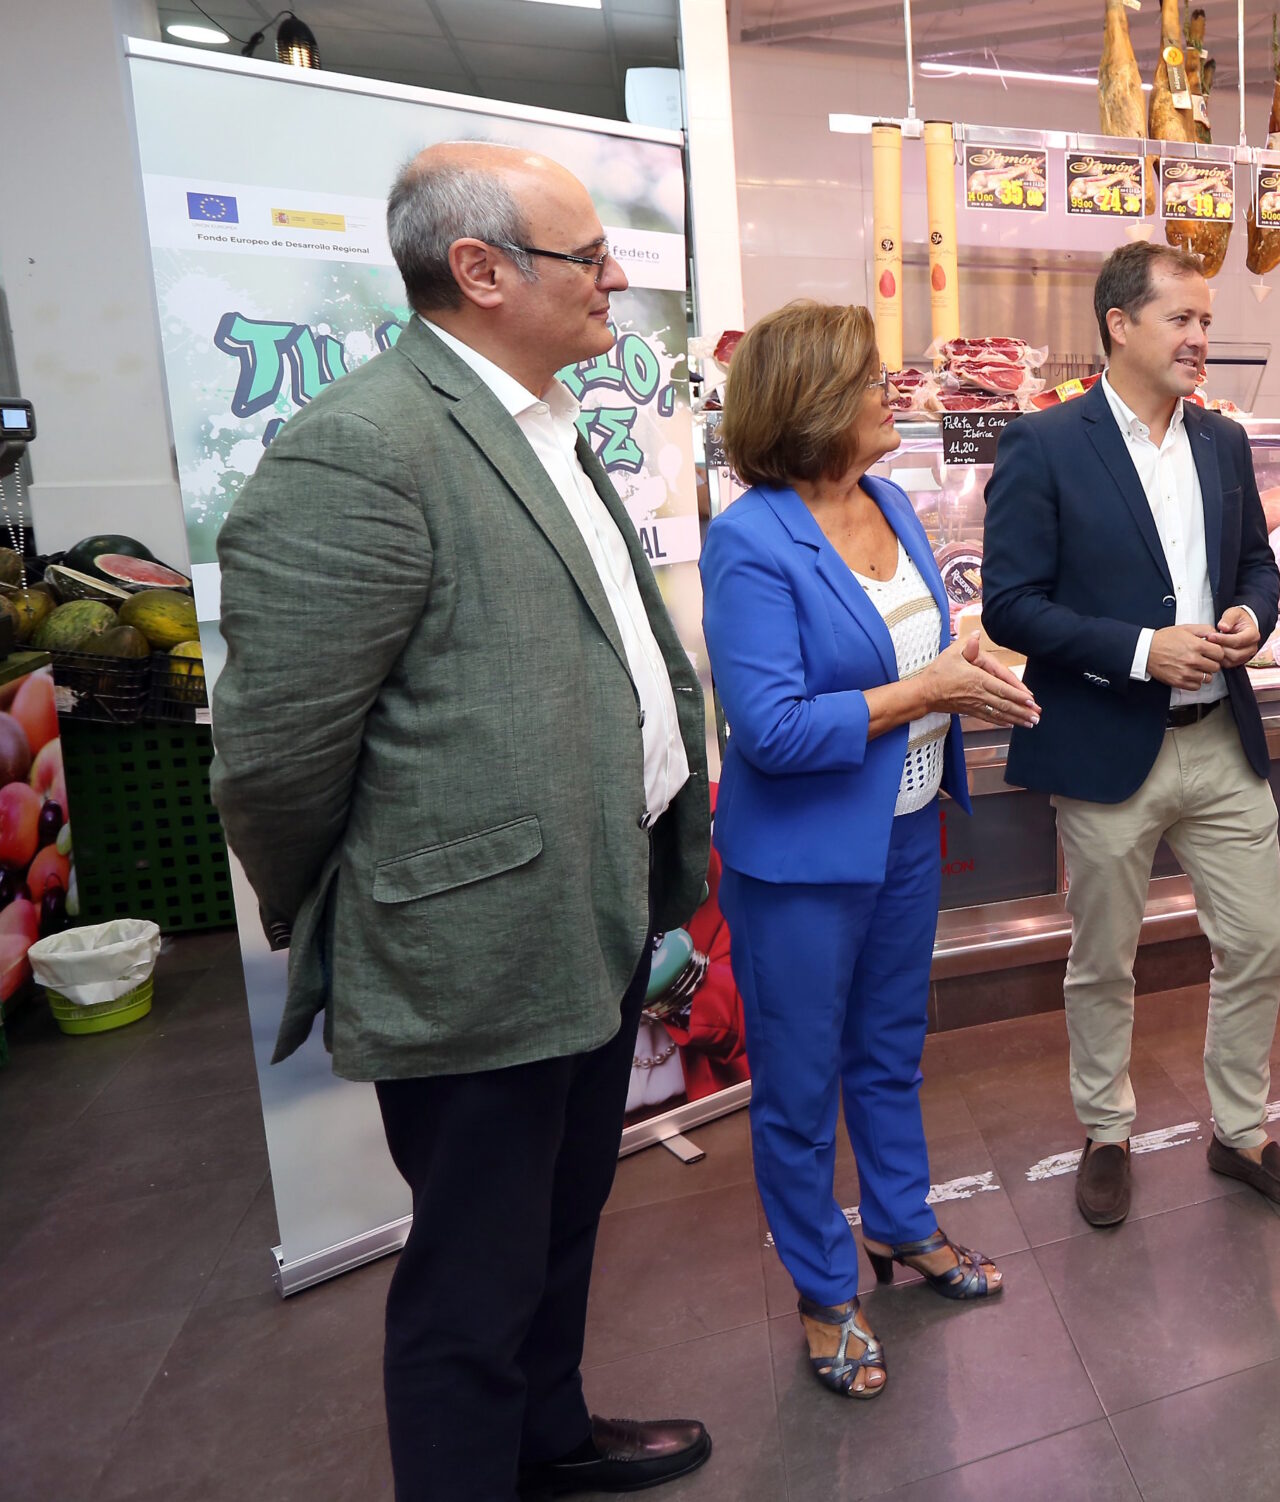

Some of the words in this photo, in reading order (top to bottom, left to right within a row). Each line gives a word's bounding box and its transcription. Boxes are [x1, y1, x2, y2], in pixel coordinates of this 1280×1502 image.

[969, 149, 1036, 166] Jamón
[1070, 156, 1133, 173] Jamón
[1165, 162, 1226, 178] Jamón
[197, 233, 228, 243] Fondo
[230, 236, 270, 247] Europeo
[272, 239, 283, 247] de
[285, 240, 331, 251] Desarrollo
[333, 244, 370, 254] Regional
[613, 245, 660, 260] fedeto
[943, 416, 972, 429] Paleta
